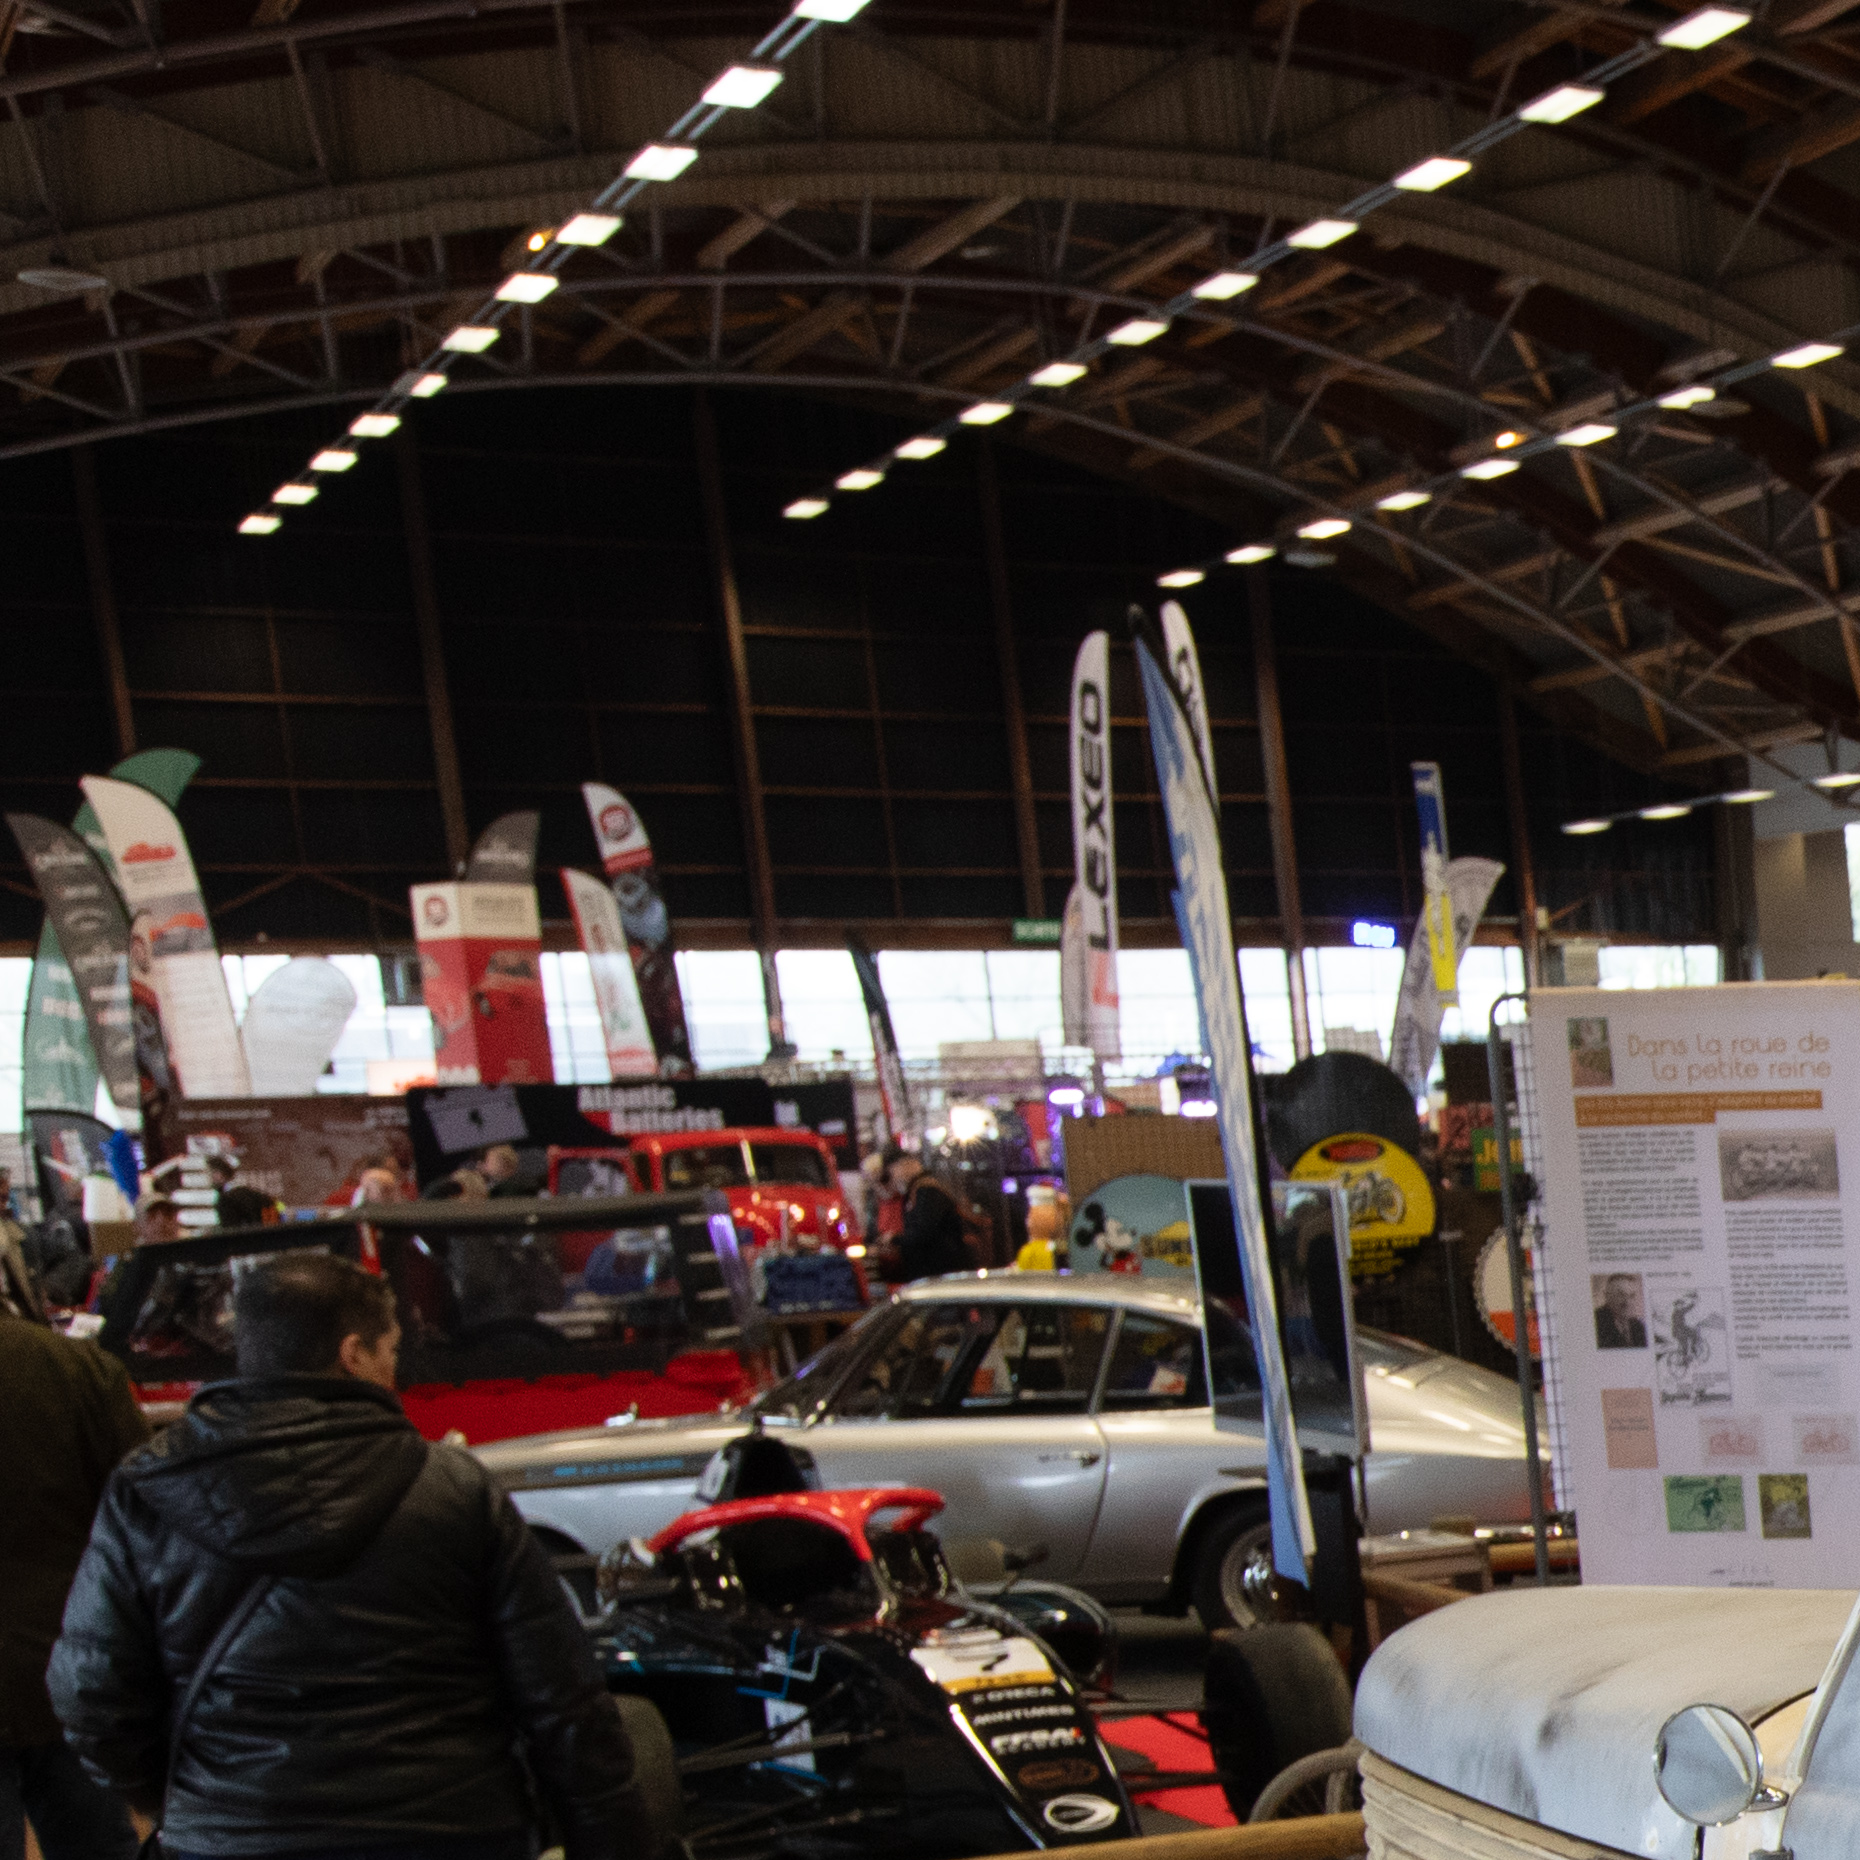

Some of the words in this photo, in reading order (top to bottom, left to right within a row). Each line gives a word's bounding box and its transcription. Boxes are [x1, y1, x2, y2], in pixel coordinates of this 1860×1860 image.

[1627, 1034, 1688, 1058] Dans
[1696, 1033, 1722, 1056] la
[1797, 1031, 1831, 1055] de
[1652, 1059, 1678, 1082] la
[1687, 1055, 1759, 1086] petite
[1768, 1056, 1832, 1080] reine
